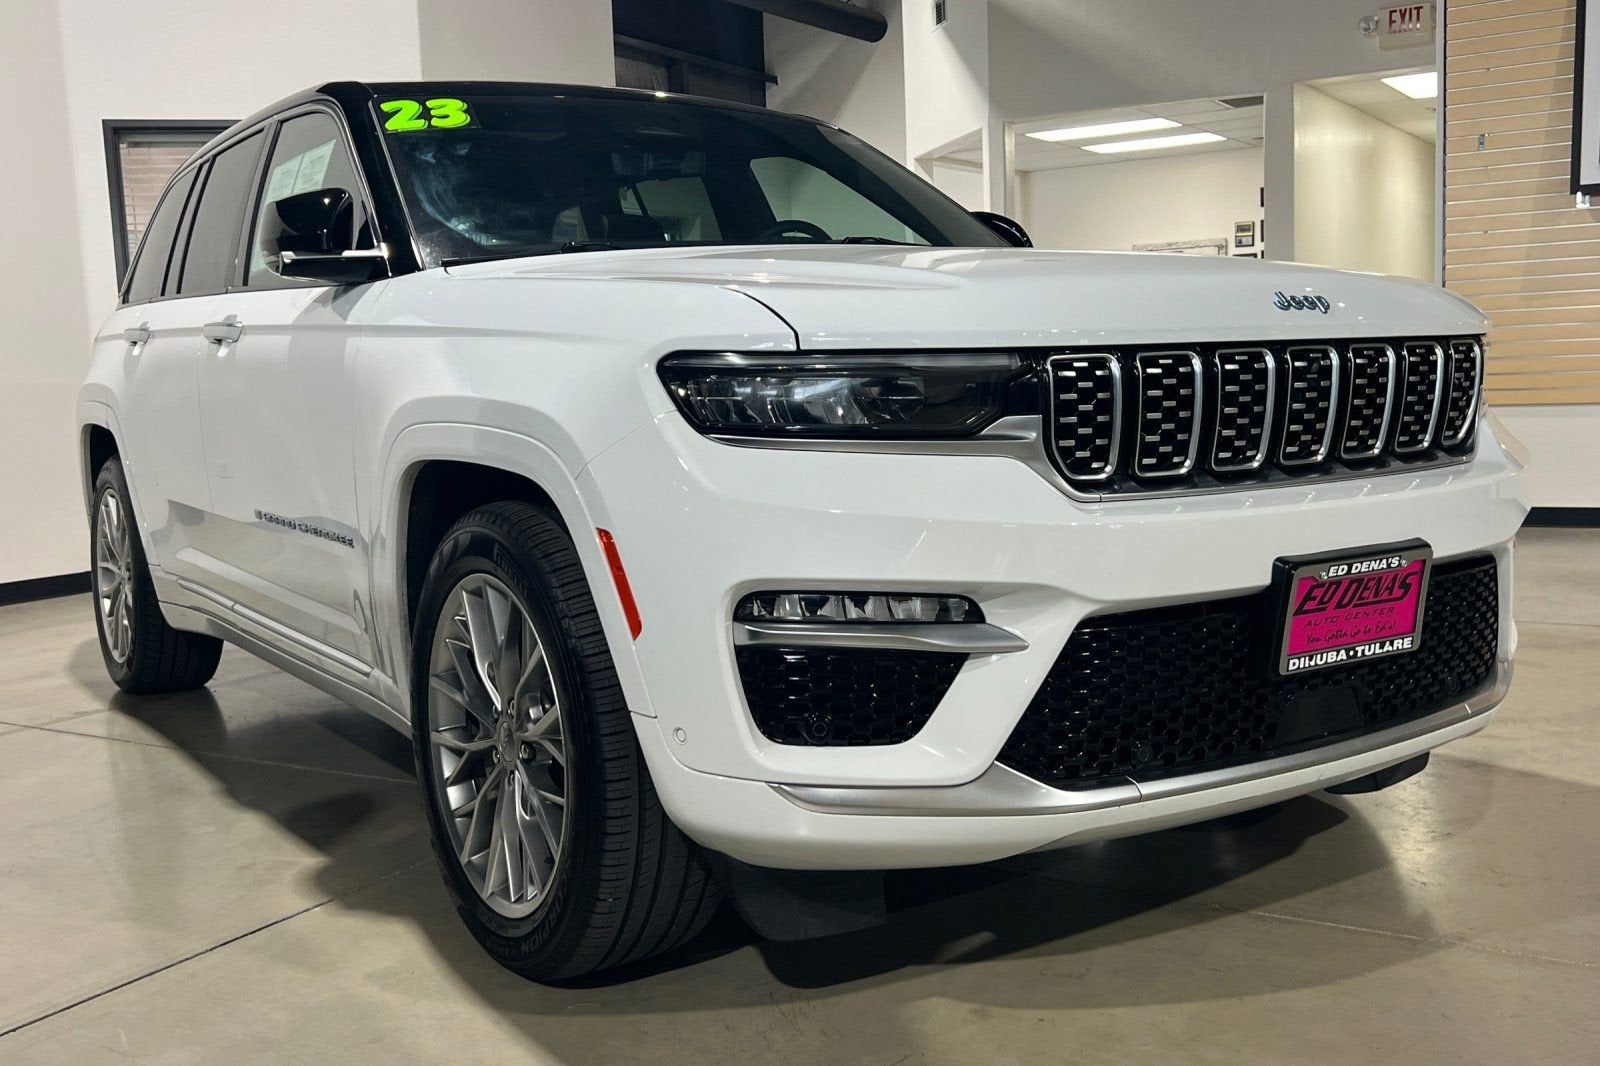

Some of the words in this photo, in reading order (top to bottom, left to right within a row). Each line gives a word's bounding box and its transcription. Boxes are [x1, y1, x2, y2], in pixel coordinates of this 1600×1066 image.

[1388, 6, 1424, 34] EXIT
[380, 98, 470, 132] 23
[1272, 289, 1330, 314] Jeep
[298, 522, 355, 549] CHEROKEE
[1328, 565, 1348, 577] ED
[1350, 556, 1401, 574] DENA'S
[1293, 579, 1343, 616] ED
[1333, 570, 1420, 610] DENA'S
[1305, 616, 1340, 627] AUTO
[1344, 607, 1395, 620] CENTER
[1350, 625, 1360, 638] Go
[1363, 624, 1372, 634] to
[1288, 649, 1347, 671] DINUBA
[1355, 637, 1413, 658] TULARE
